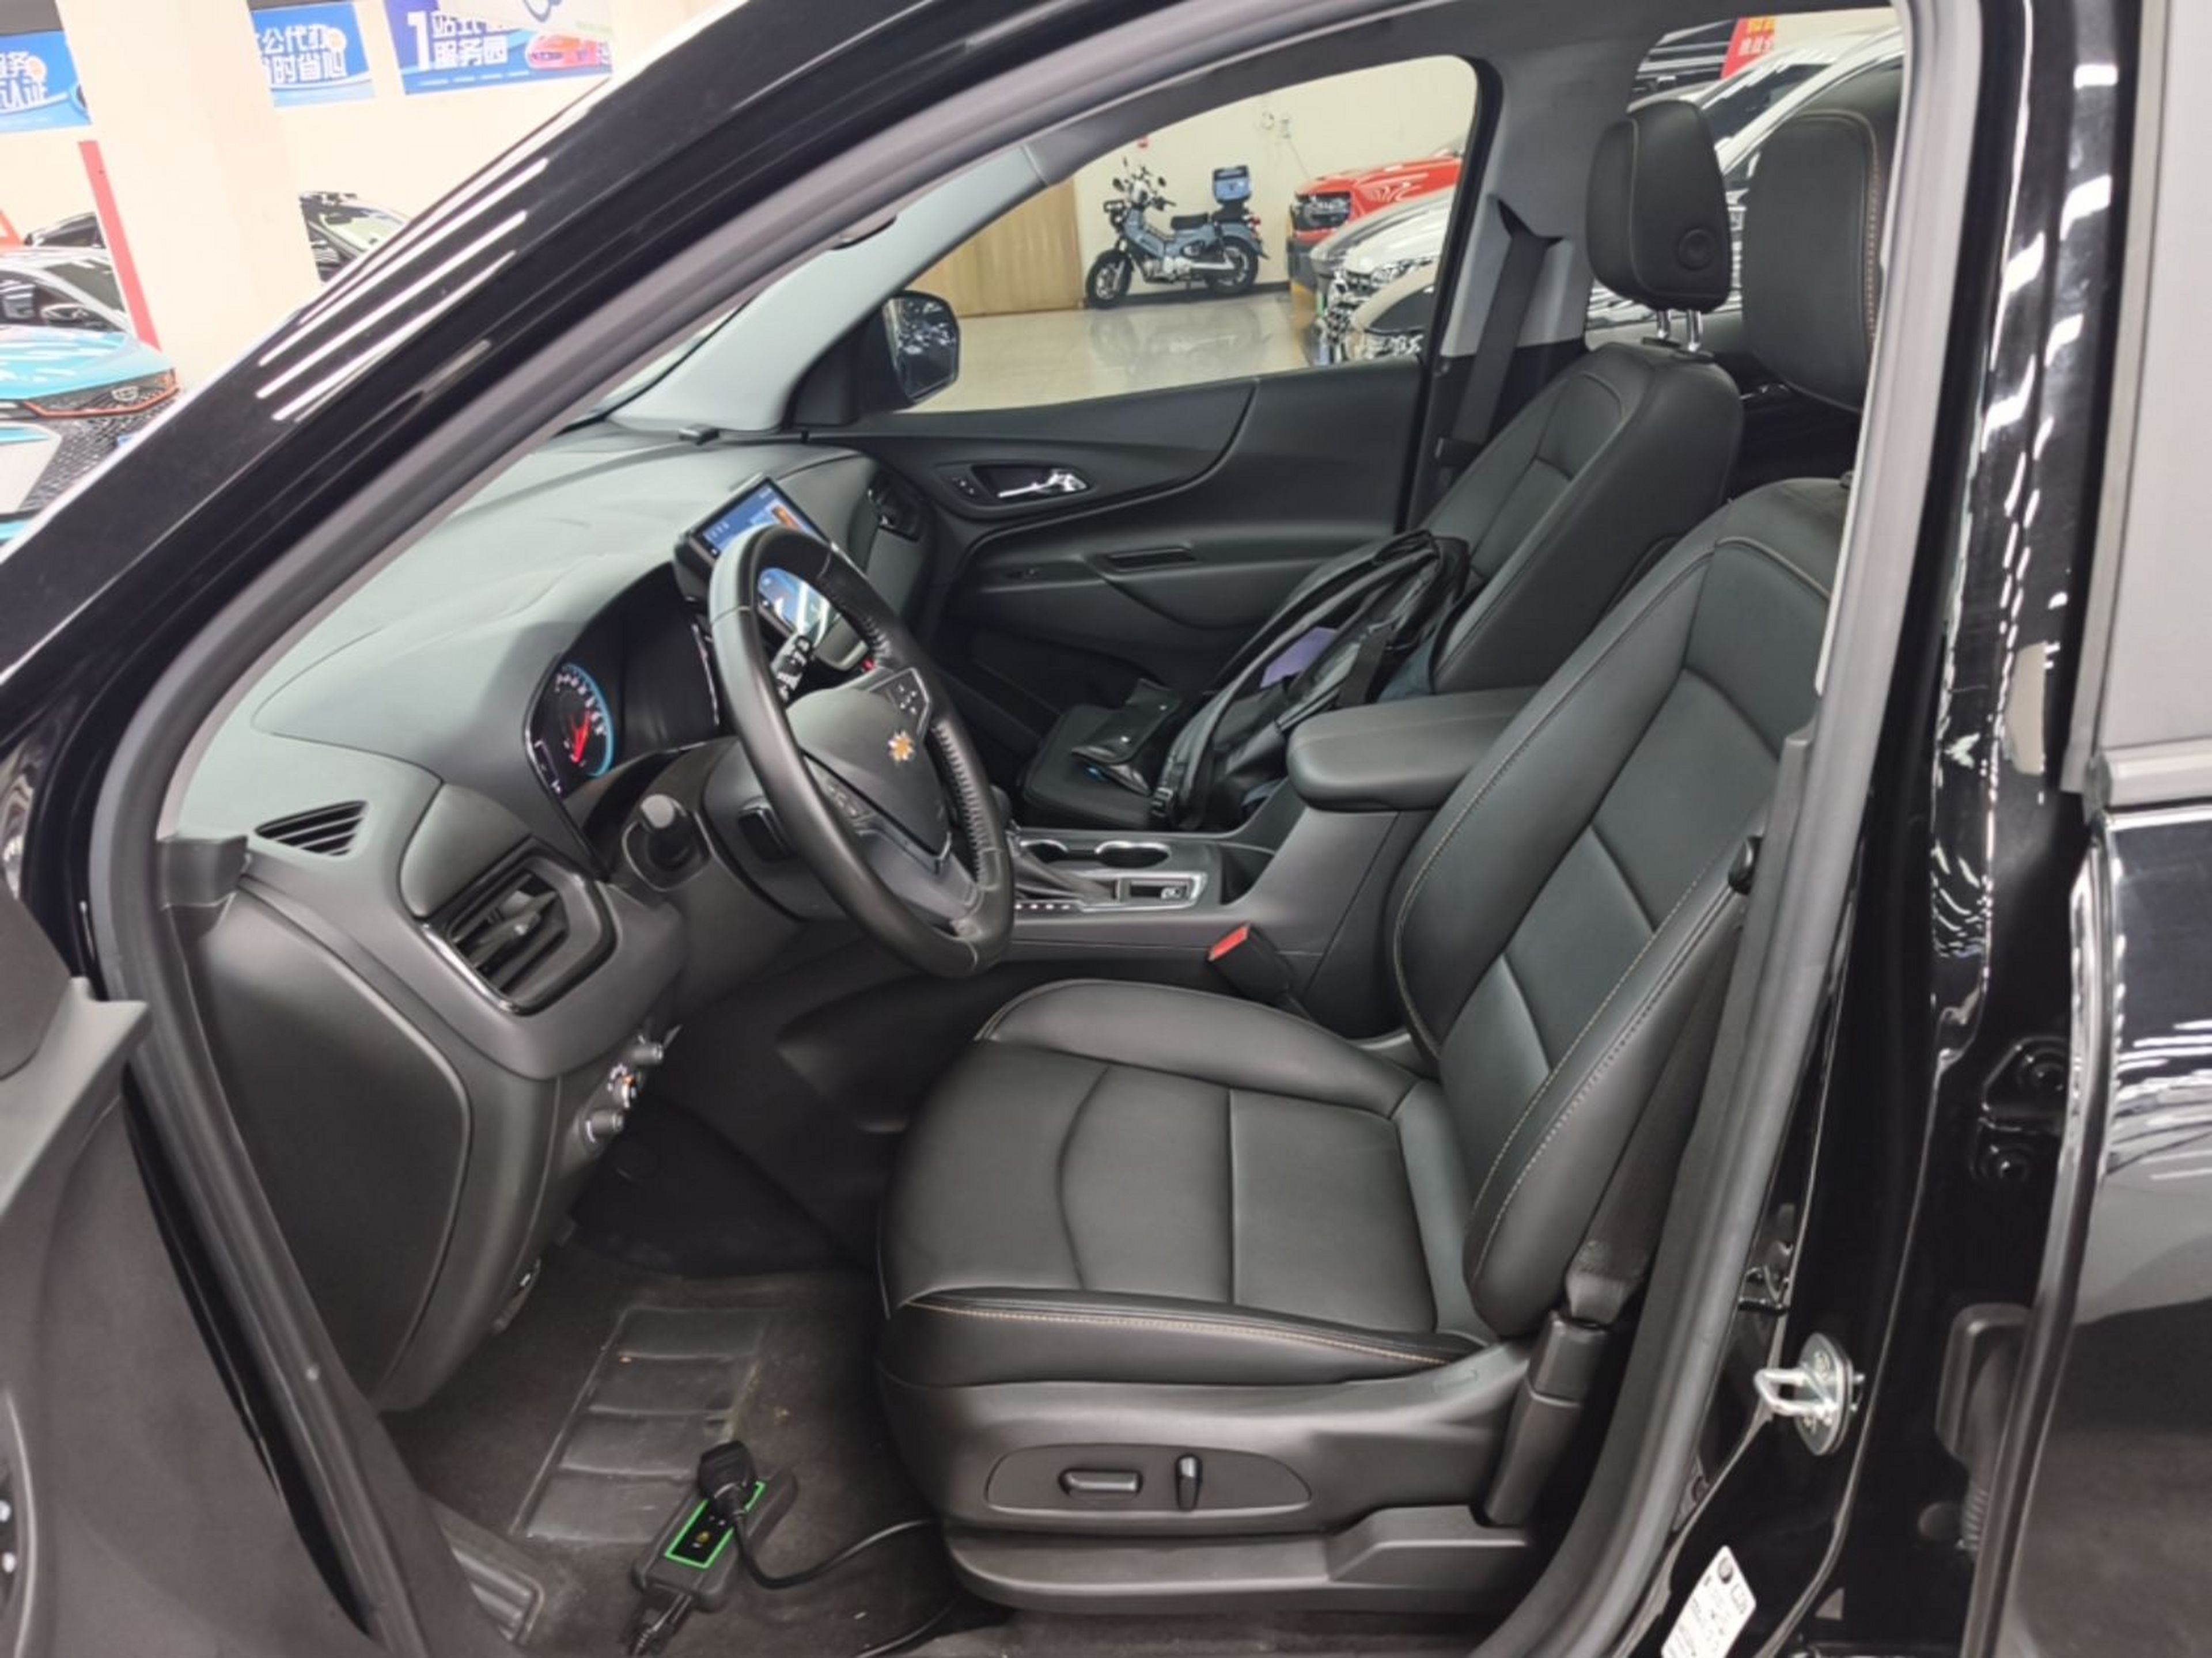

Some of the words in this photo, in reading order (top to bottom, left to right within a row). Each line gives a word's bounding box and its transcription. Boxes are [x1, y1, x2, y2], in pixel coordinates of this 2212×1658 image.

[431, 12, 508, 38] 站式
[407, 11, 430, 71] 1
[0, 51, 29, 78] 务
